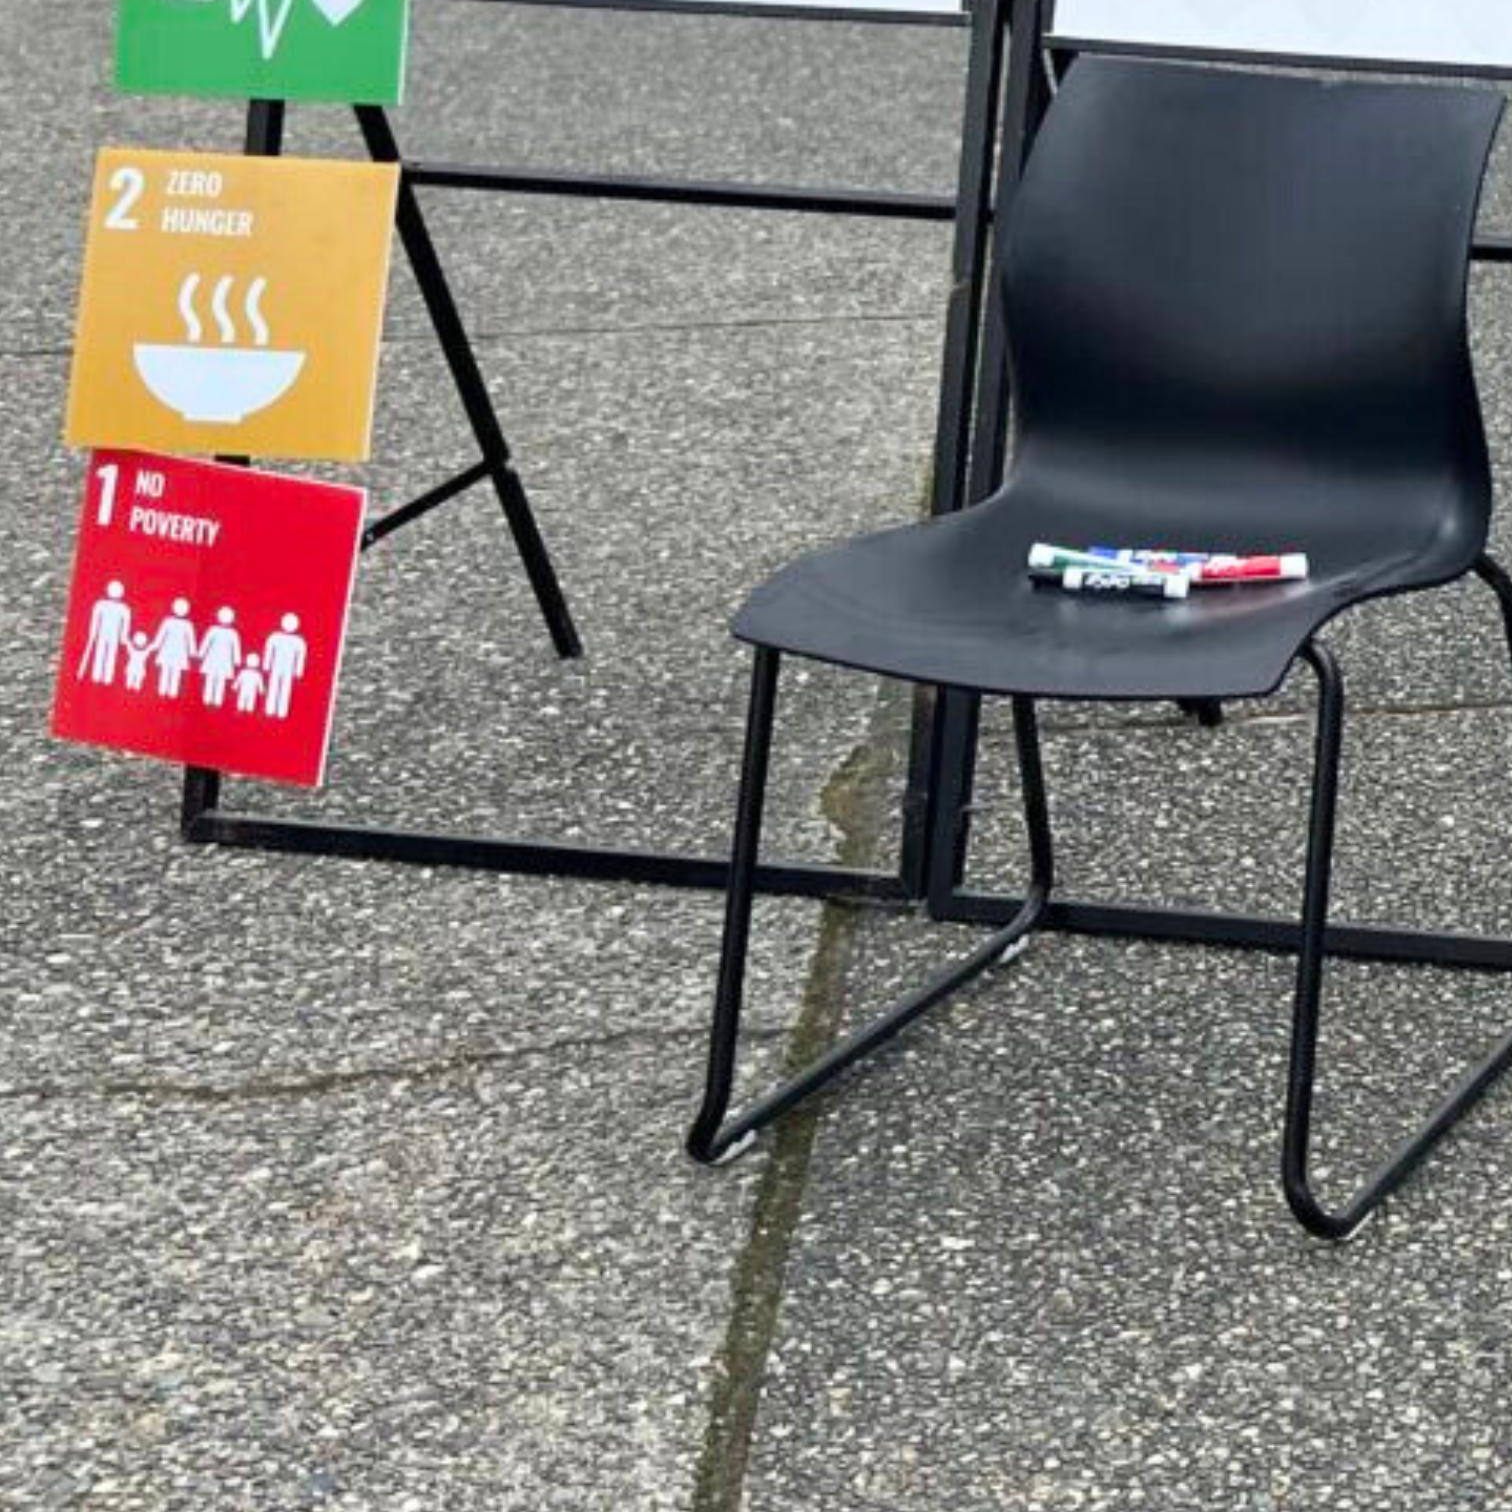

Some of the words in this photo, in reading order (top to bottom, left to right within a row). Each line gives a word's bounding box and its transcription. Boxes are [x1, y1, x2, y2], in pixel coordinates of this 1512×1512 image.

[104, 166, 145, 231] 2
[166, 170, 223, 198] ZERO
[160, 206, 254, 237] HUNGER
[96, 463, 119, 527] 1
[135, 469, 166, 498] NO
[129, 505, 222, 548] POVERTY
